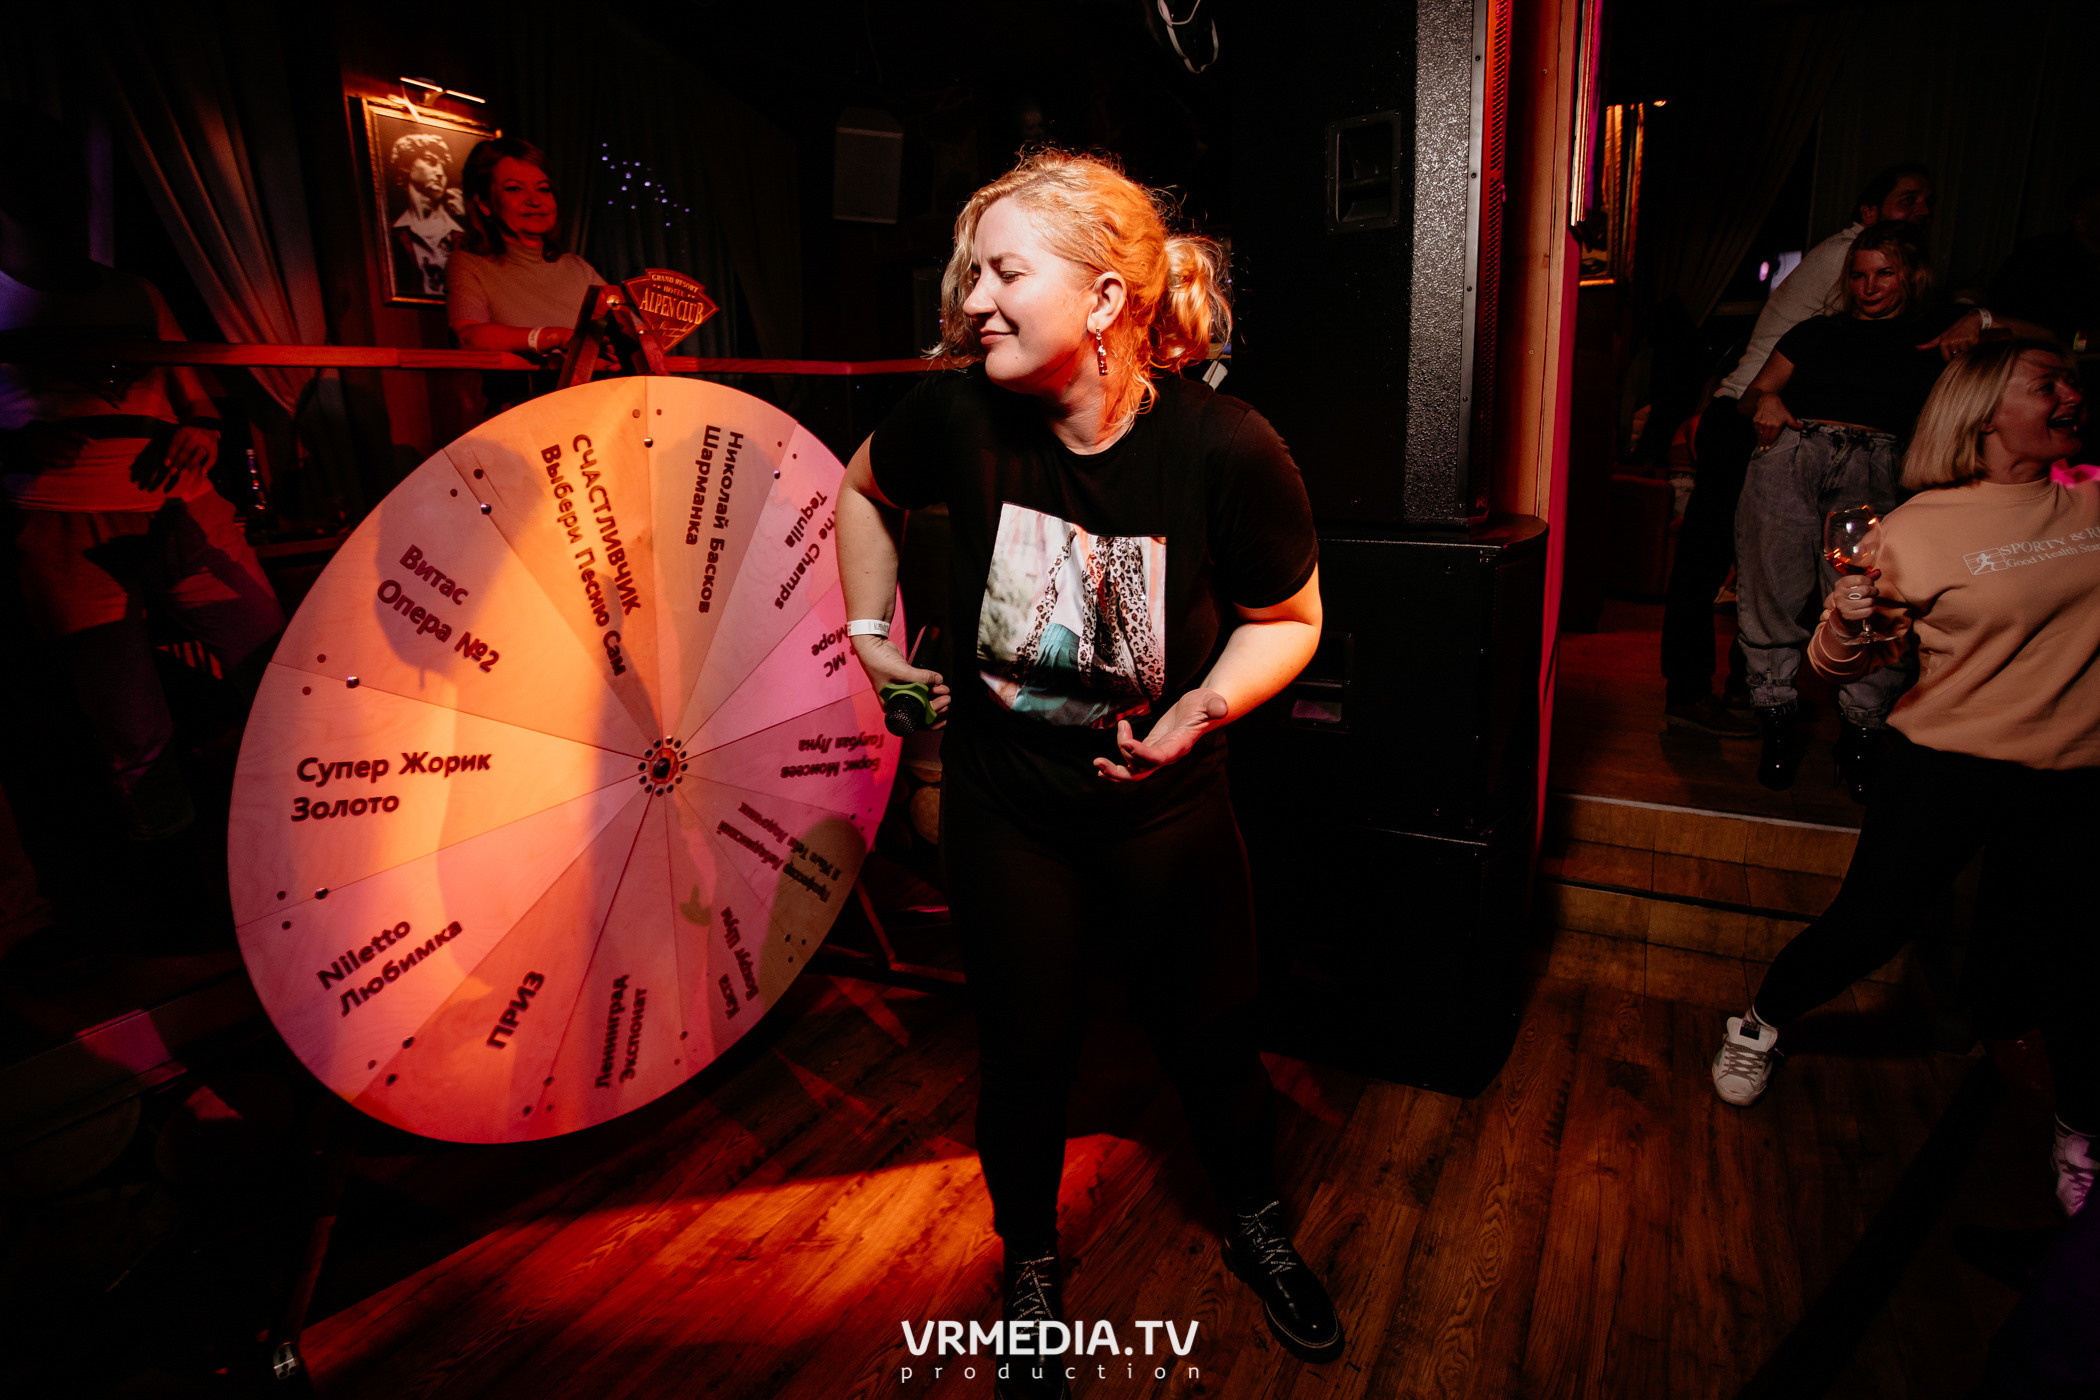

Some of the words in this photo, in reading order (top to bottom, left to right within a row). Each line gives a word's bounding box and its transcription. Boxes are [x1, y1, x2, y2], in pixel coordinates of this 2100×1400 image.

[639, 288, 674, 317] ALPEN
[676, 300, 704, 325] CLUB
[675, 279, 700, 293] RESORT
[686, 425, 720, 546] Шарманка
[713, 431, 744, 530] Николай
[573, 433, 641, 616] СЧАСТЛИВЧИК
[785, 490, 828, 548] Tequila
[819, 510, 836, 540] he
[2000, 538, 2066, 555] SPORTY
[2069, 532, 2086, 541] &
[399, 545, 469, 606] Витас
[541, 445, 582, 544] Выбери
[575, 548, 610, 628] Песню
[603, 630, 627, 676] Сам
[698, 538, 724, 613] Басков
[774, 544, 820, 610] Champs
[2007, 557, 2037, 568] Good
[2038, 546, 2078, 560] Health
[377, 579, 451, 644] Опера
[455, 632, 500, 674] №2
[297, 756, 389, 787] Супер
[399, 750, 492, 778] Жорик
[781, 760, 840, 778] Моисеев
[799, 736, 832, 753] Луна
[291, 792, 400, 822] Золото
[316, 918, 412, 991] Niletto
[339, 920, 464, 1018] Любимка
[486, 971, 546, 1050] ПРИЗ
[595, 974, 629, 1089] Ленинград
[620, 988, 647, 1084] Экспонат
